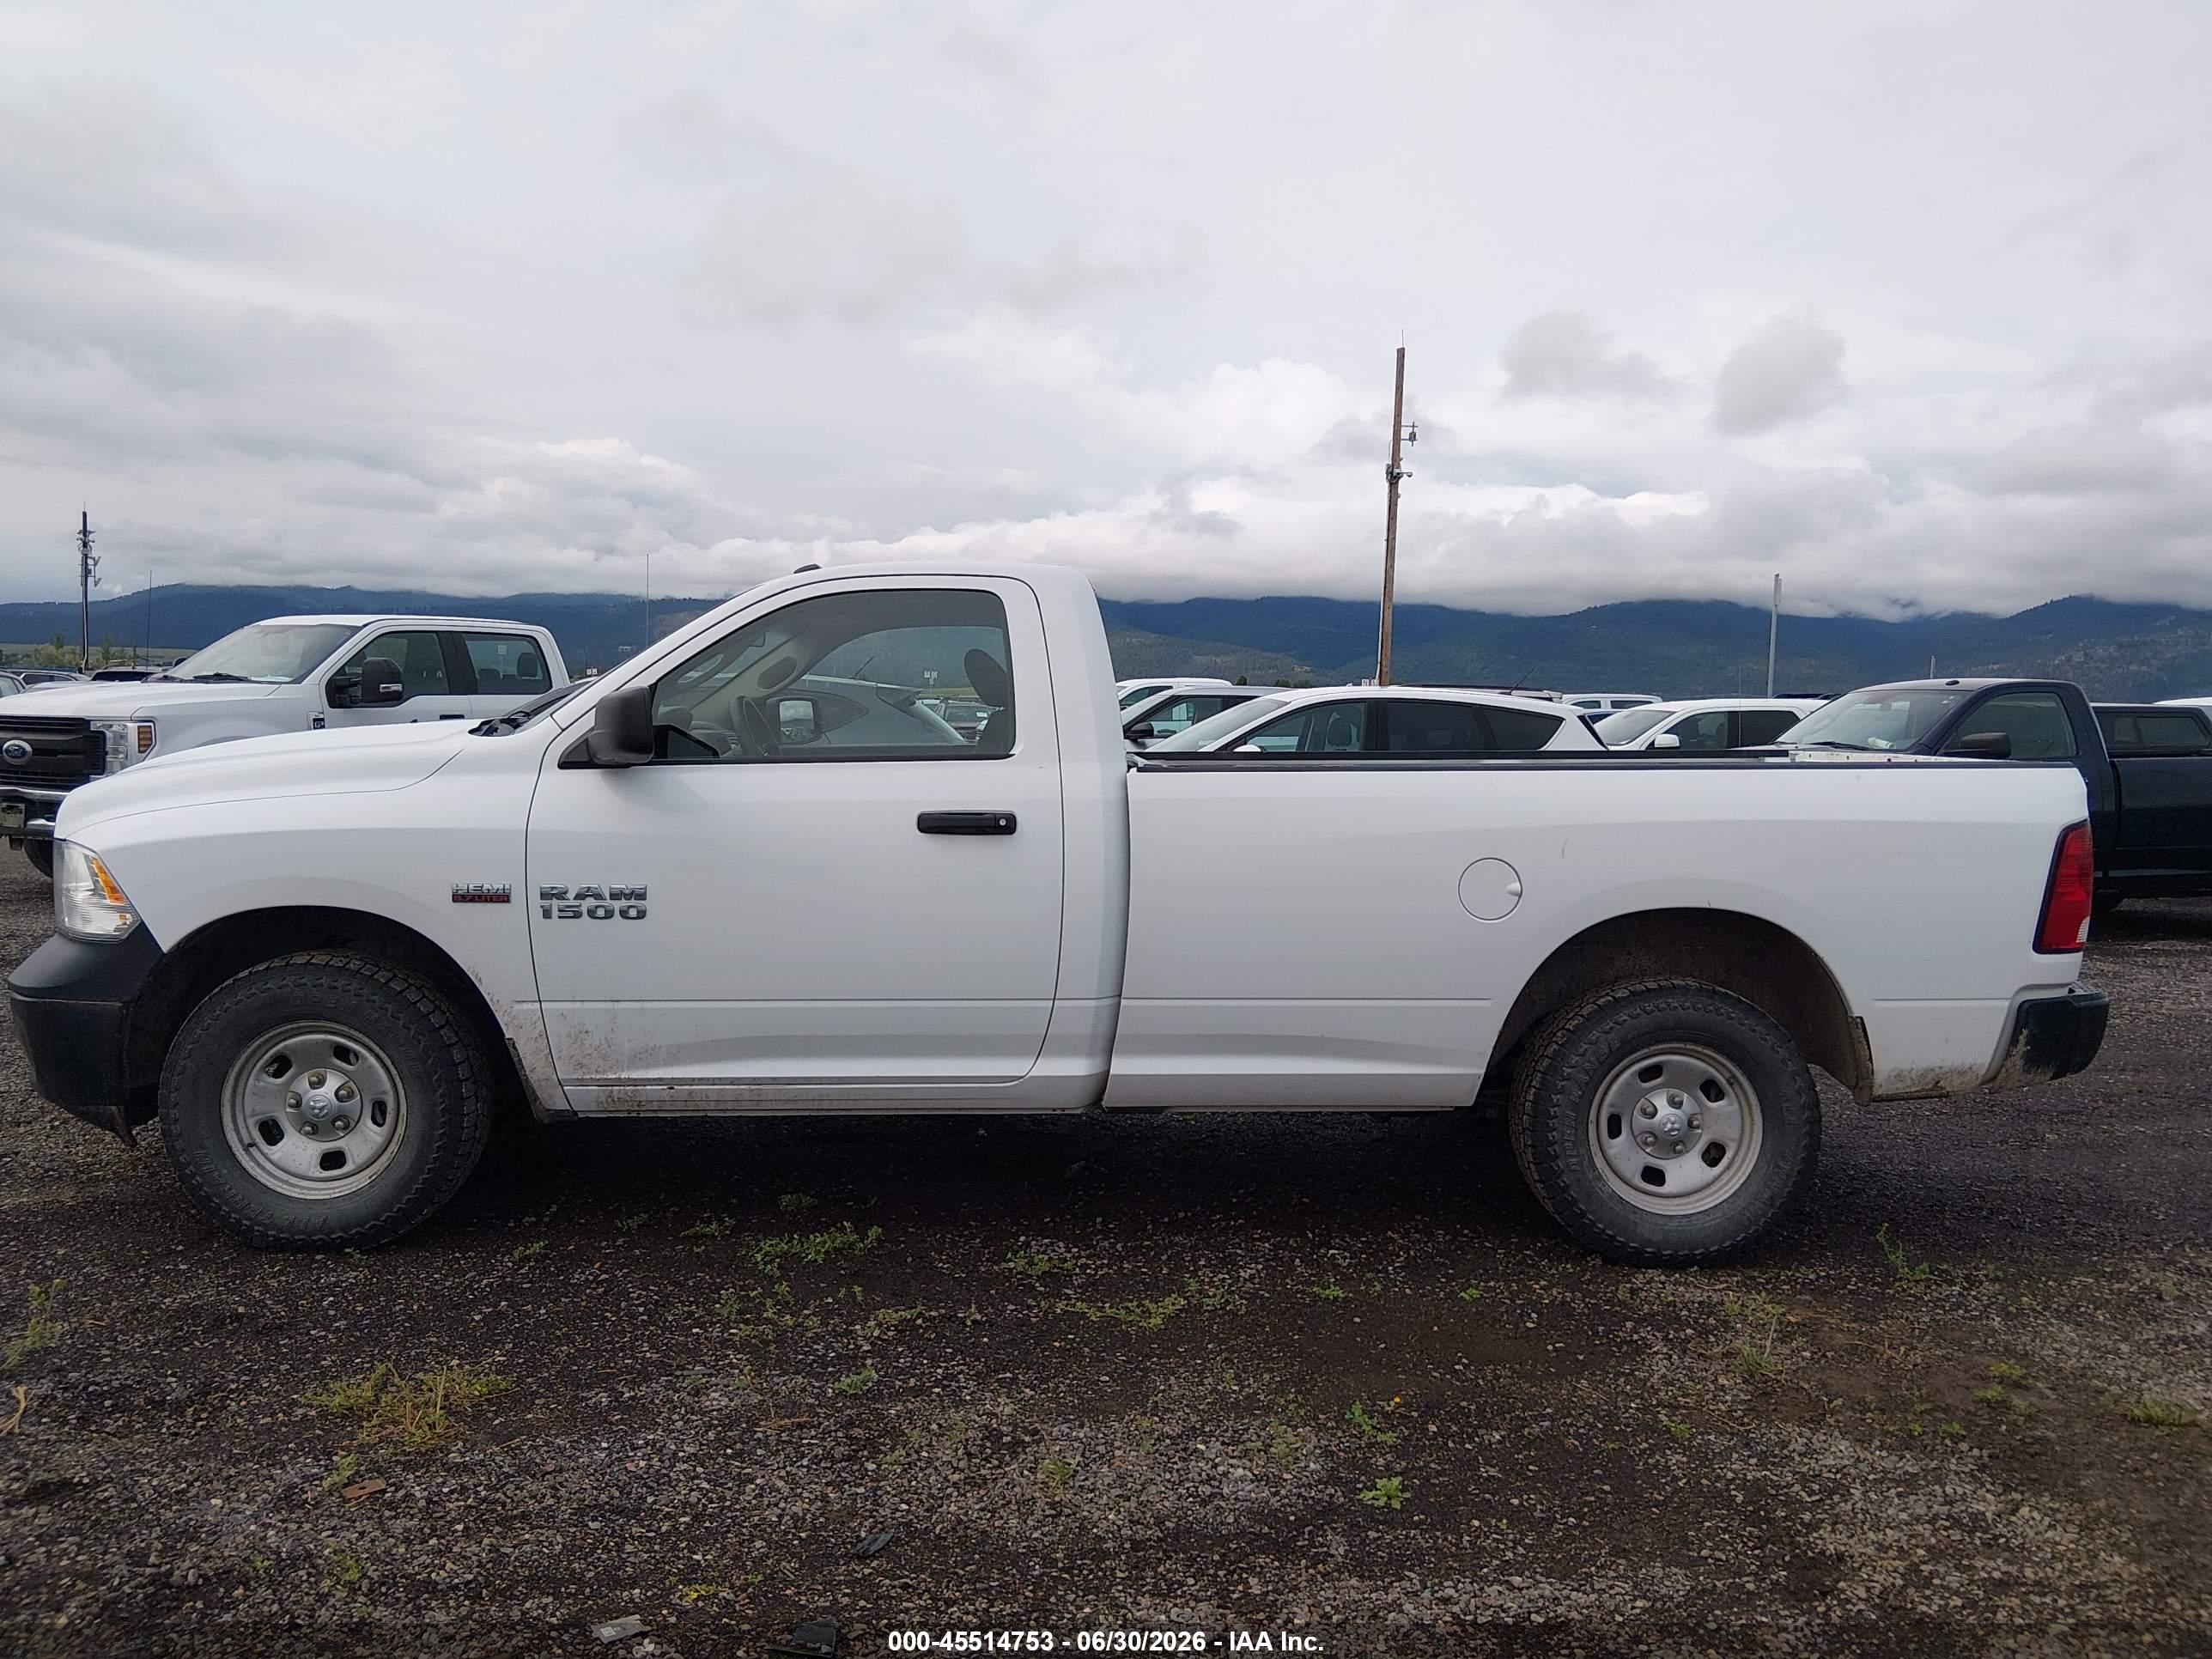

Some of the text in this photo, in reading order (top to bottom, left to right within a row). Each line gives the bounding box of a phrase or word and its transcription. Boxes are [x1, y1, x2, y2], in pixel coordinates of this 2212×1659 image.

[452, 884, 511, 893] HEMI
[540, 884, 647, 901] RAM
[540, 902, 647, 920] 1500
